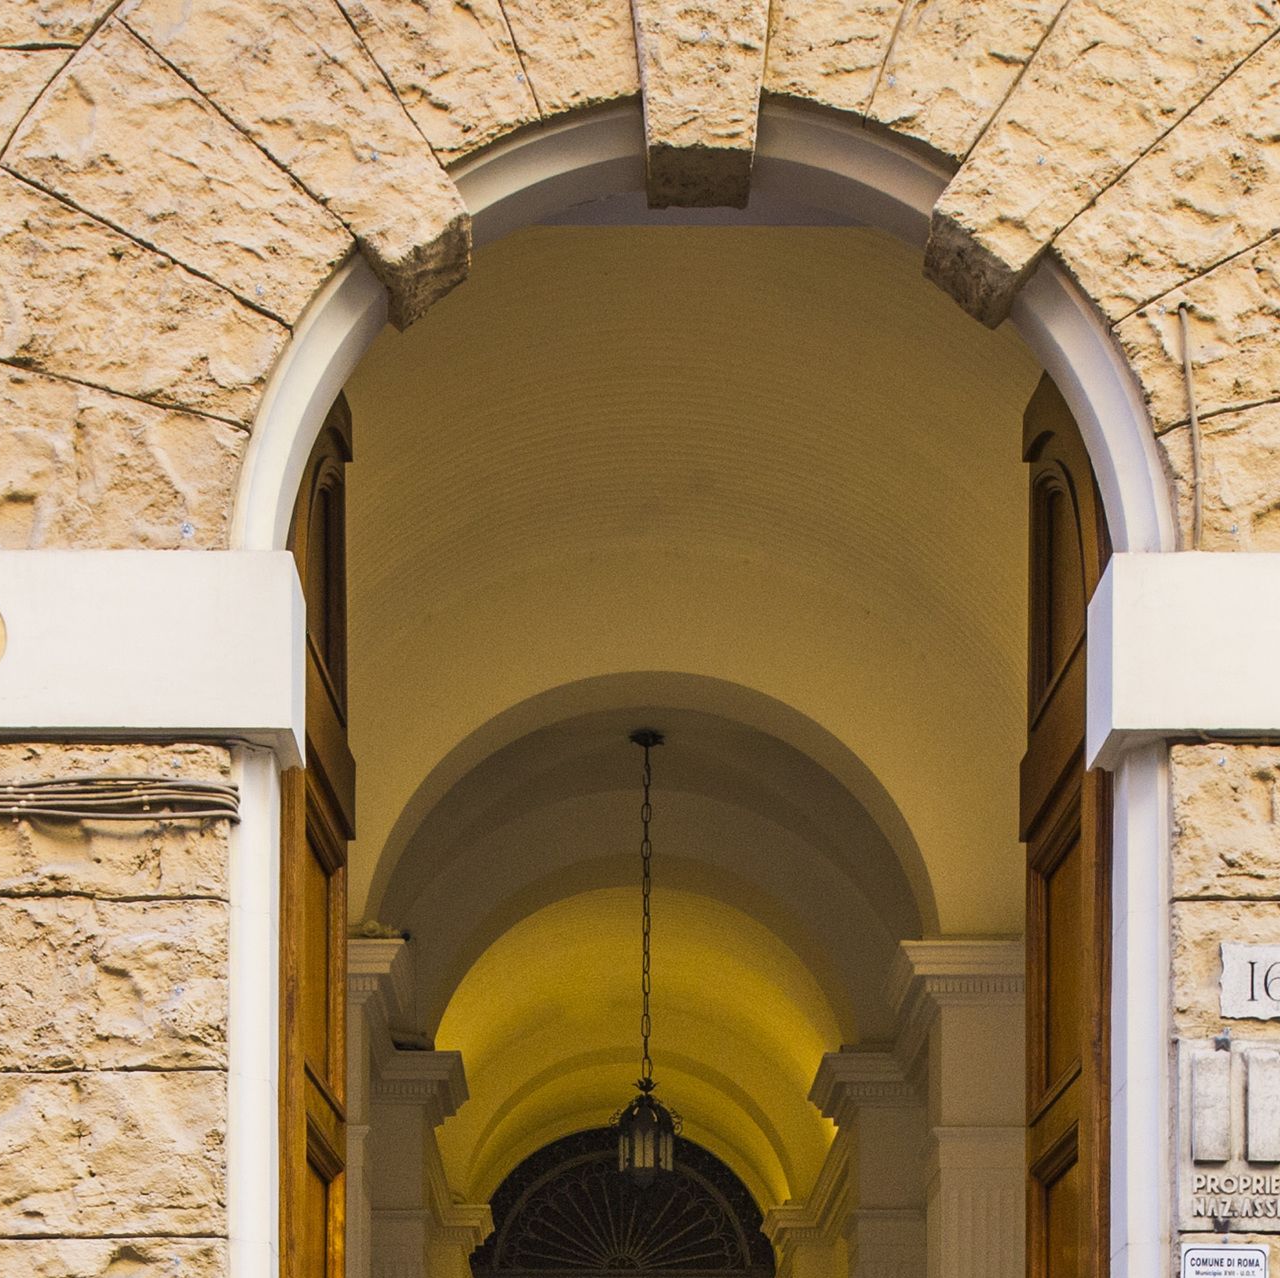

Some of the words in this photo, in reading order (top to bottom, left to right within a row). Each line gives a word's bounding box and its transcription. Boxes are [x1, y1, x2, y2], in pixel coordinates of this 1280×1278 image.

[1190, 1257, 1225, 1267] COMUNE
[1227, 1258, 1235, 1267] DI
[1237, 1258, 1260, 1267] ROMA
